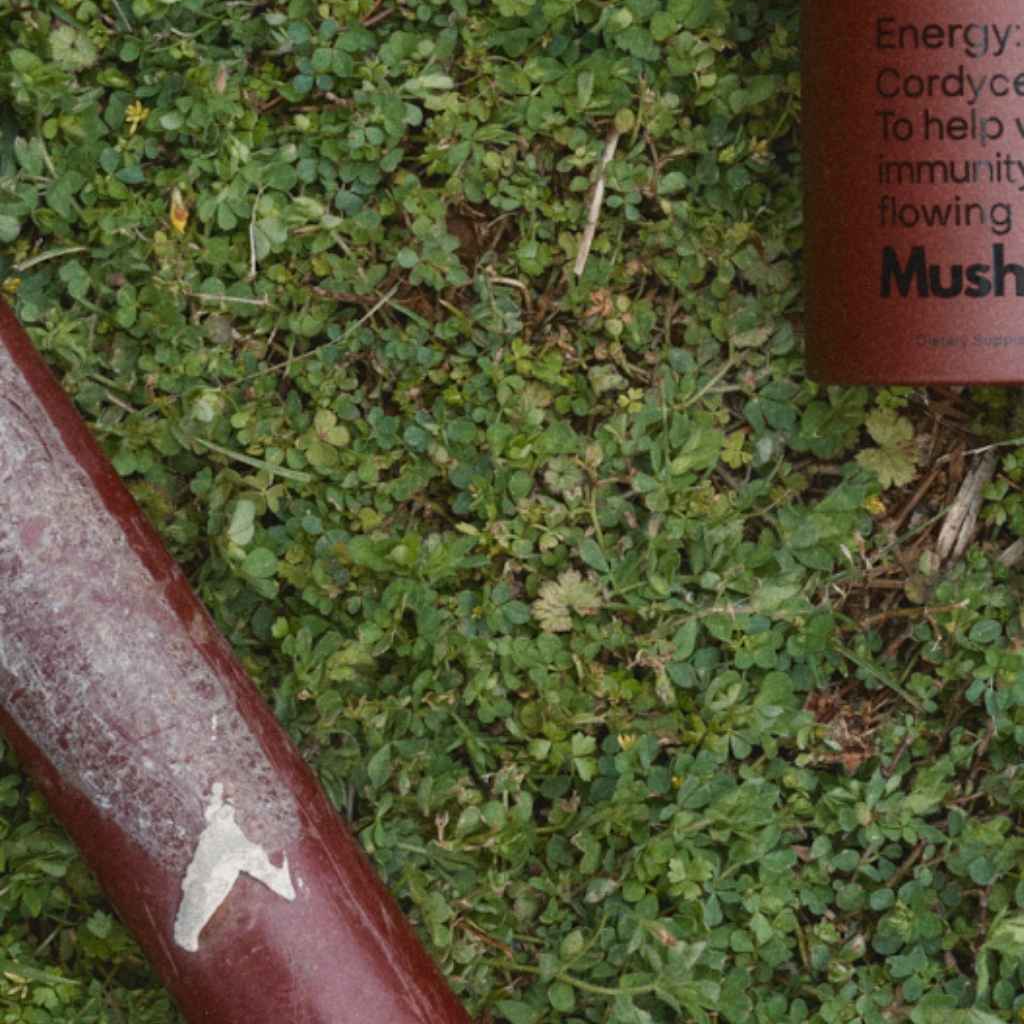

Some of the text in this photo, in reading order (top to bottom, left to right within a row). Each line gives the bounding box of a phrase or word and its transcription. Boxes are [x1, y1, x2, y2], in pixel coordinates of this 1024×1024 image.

[876, 17, 1021, 58] Energy:
[879, 111, 913, 142] To
[924, 108, 1004, 145] help
[879, 195, 1012, 235] flowing
